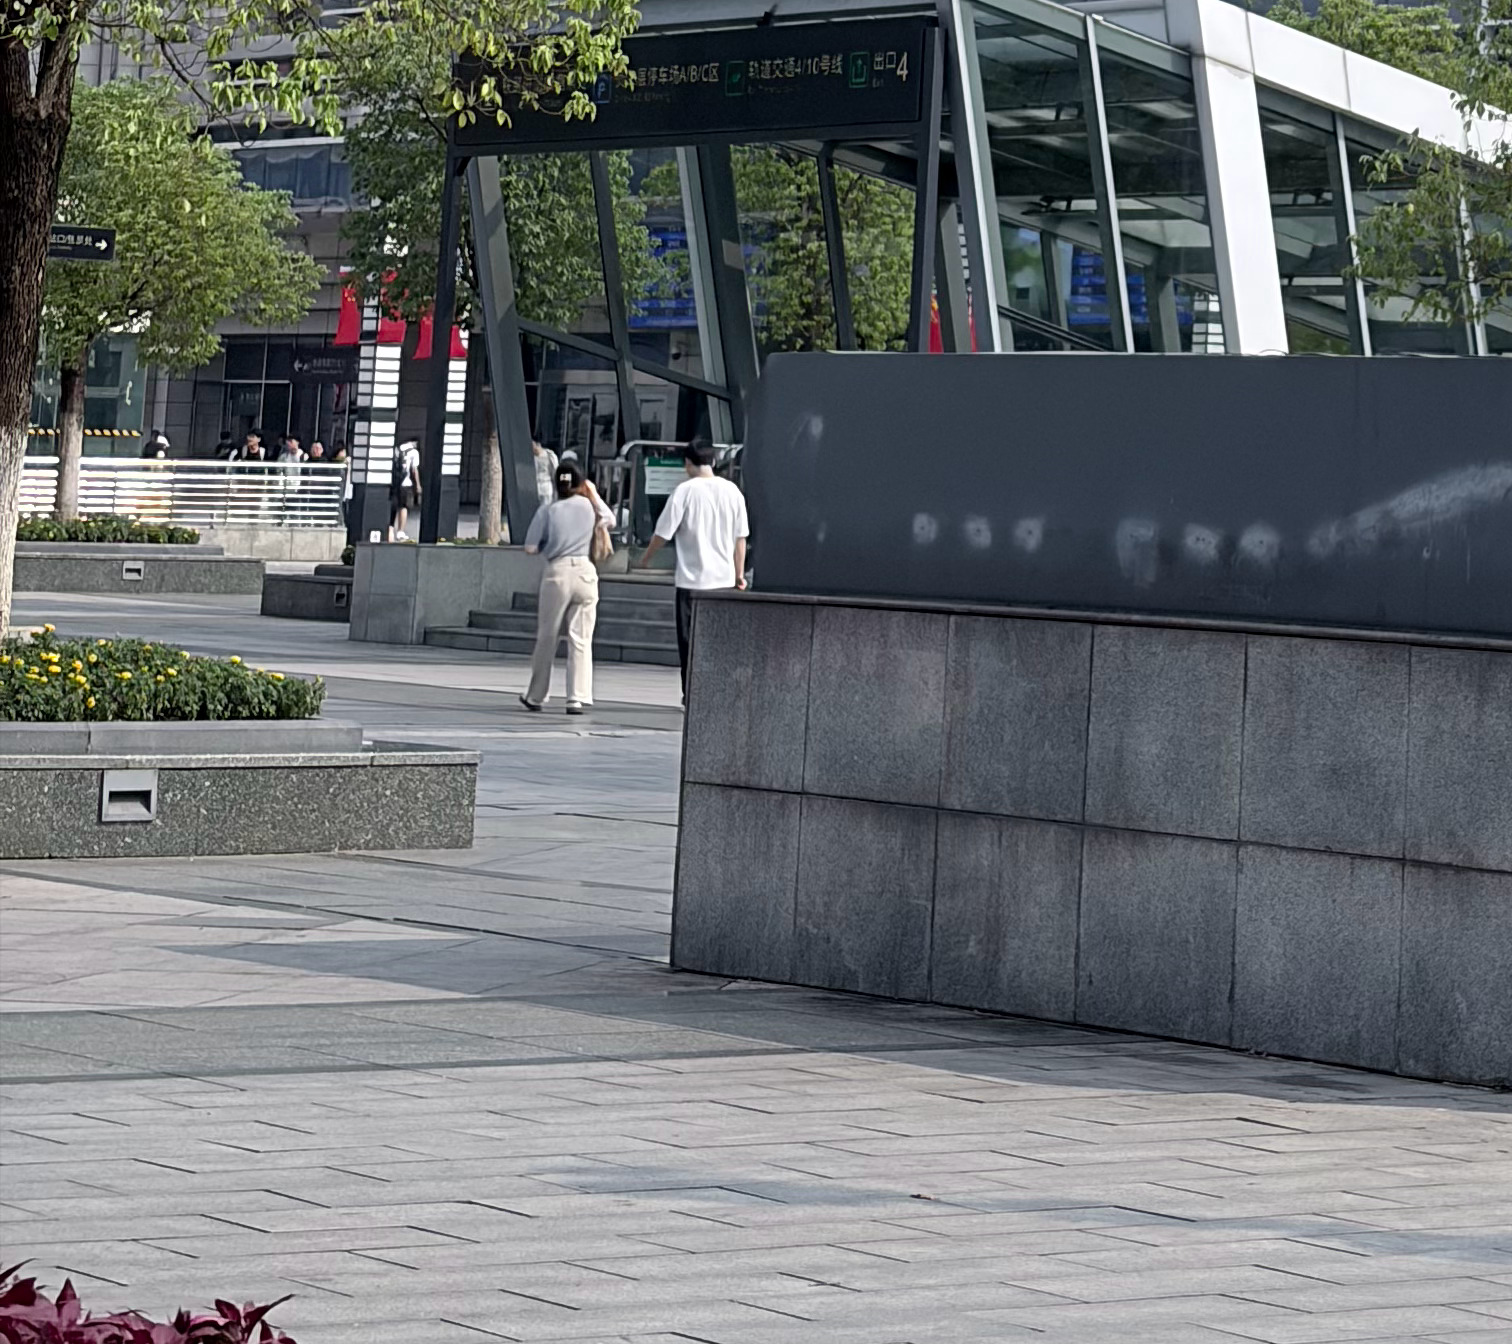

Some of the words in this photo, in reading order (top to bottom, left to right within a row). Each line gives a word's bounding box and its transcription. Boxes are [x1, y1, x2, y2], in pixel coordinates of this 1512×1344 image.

[748, 53, 843, 79] 轨道交通4/10号线
[873, 51, 897, 70] 出口
[896, 50, 909, 82] 4
